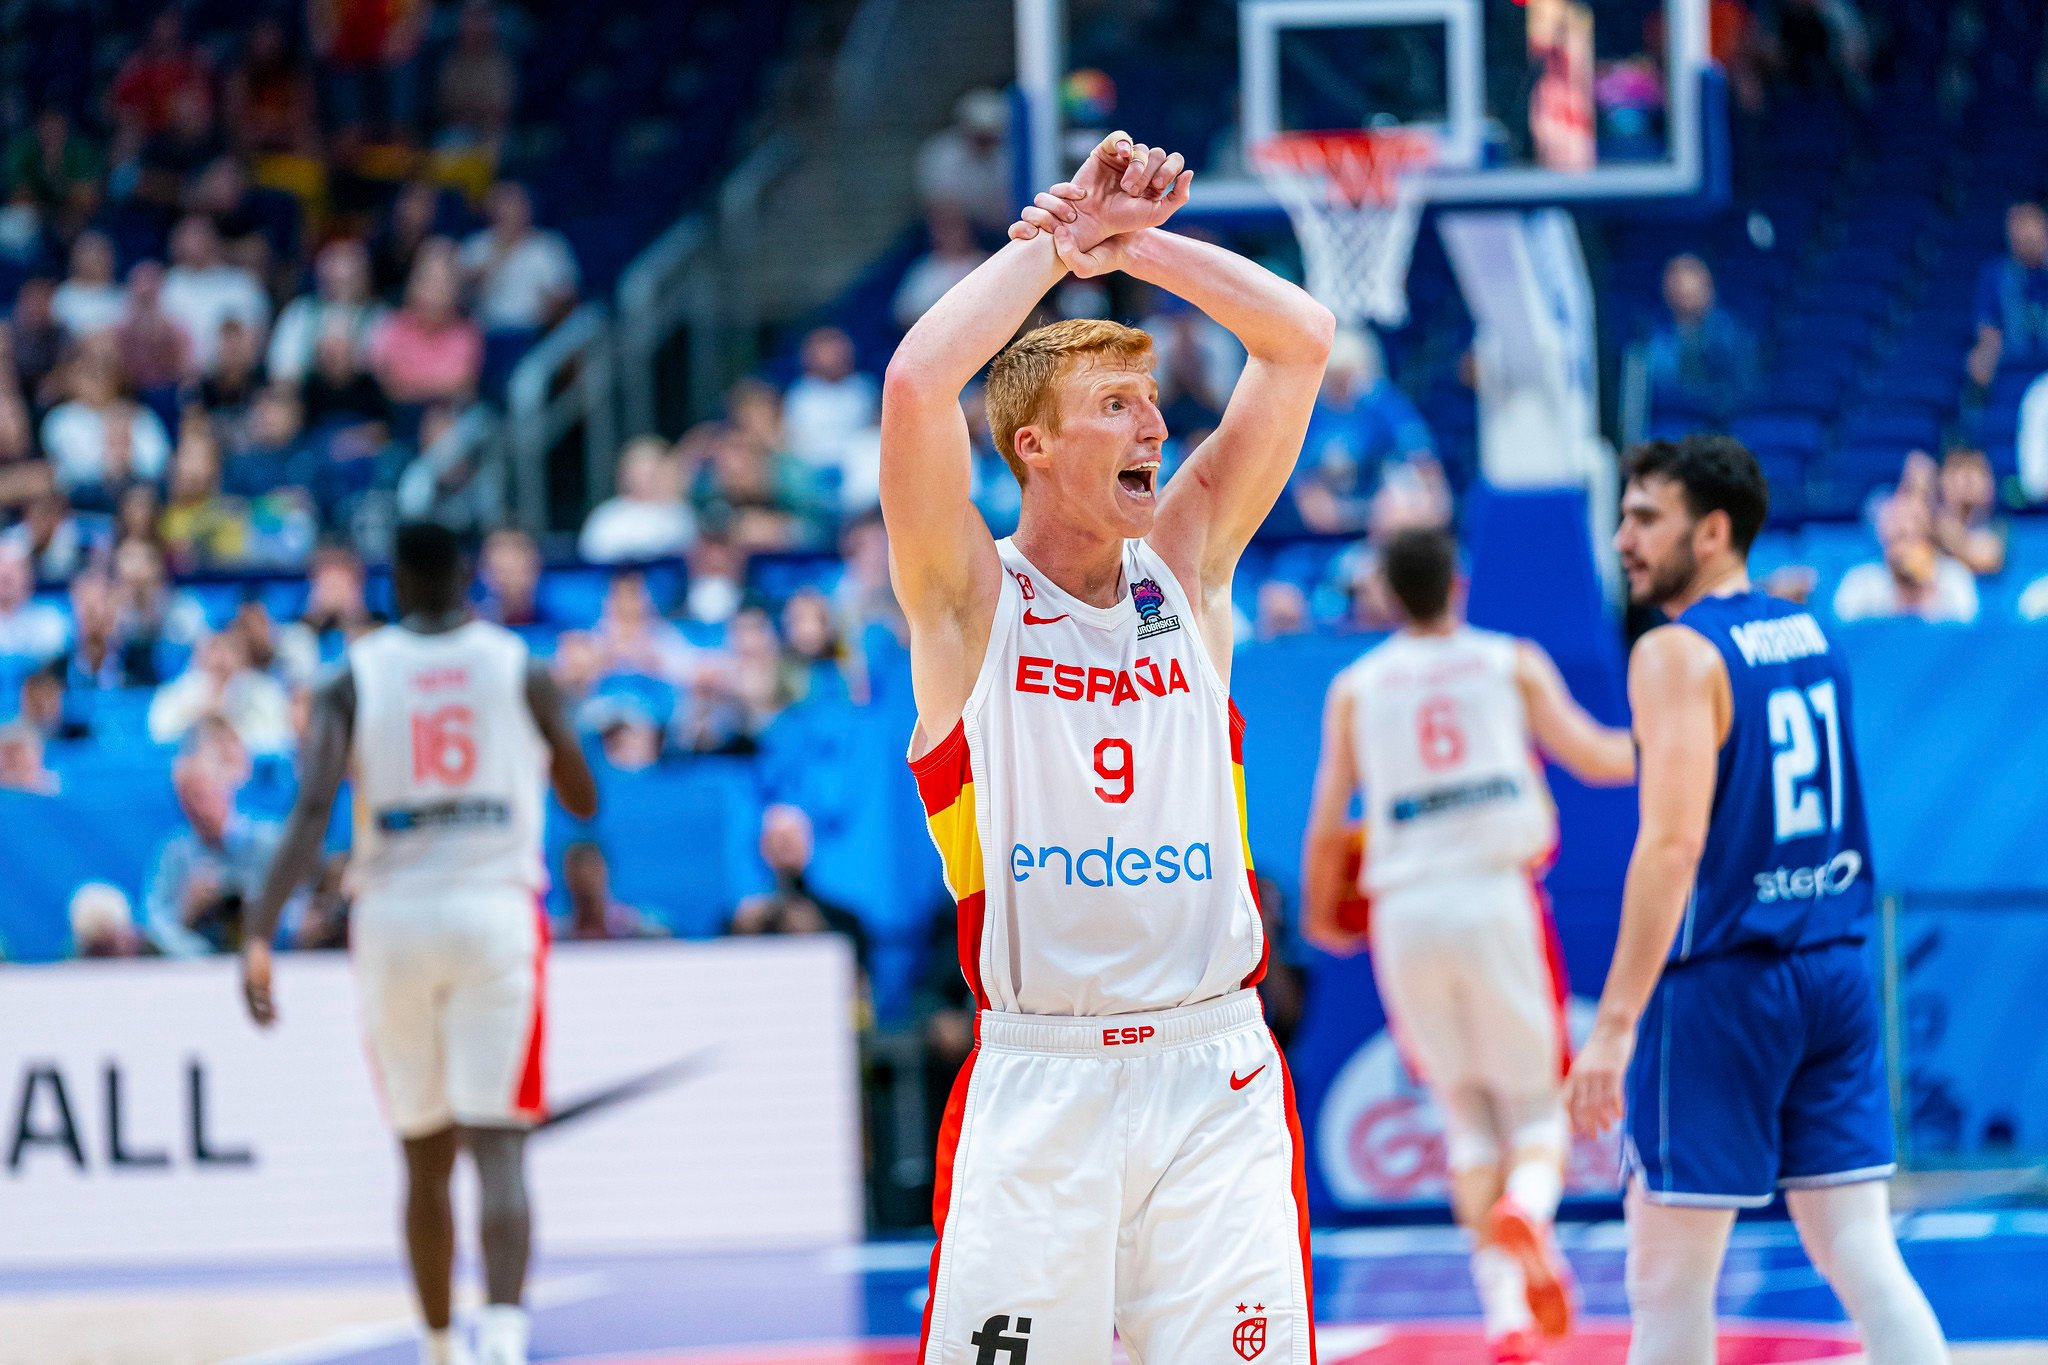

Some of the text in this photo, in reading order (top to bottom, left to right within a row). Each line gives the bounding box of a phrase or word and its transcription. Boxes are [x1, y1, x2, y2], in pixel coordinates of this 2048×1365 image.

[1137, 617, 1178, 634] UROBASKET
[1016, 654, 1190, 706] ESPAÑA
[410, 704, 477, 787] 16
[1415, 695, 1468, 774] 6
[1767, 676, 1843, 845] 21
[1093, 738, 1135, 803] 9
[1010, 837, 1213, 887] endesa
[1102, 1025, 1155, 1046] ESP
[7, 1062, 258, 1171] ALL
